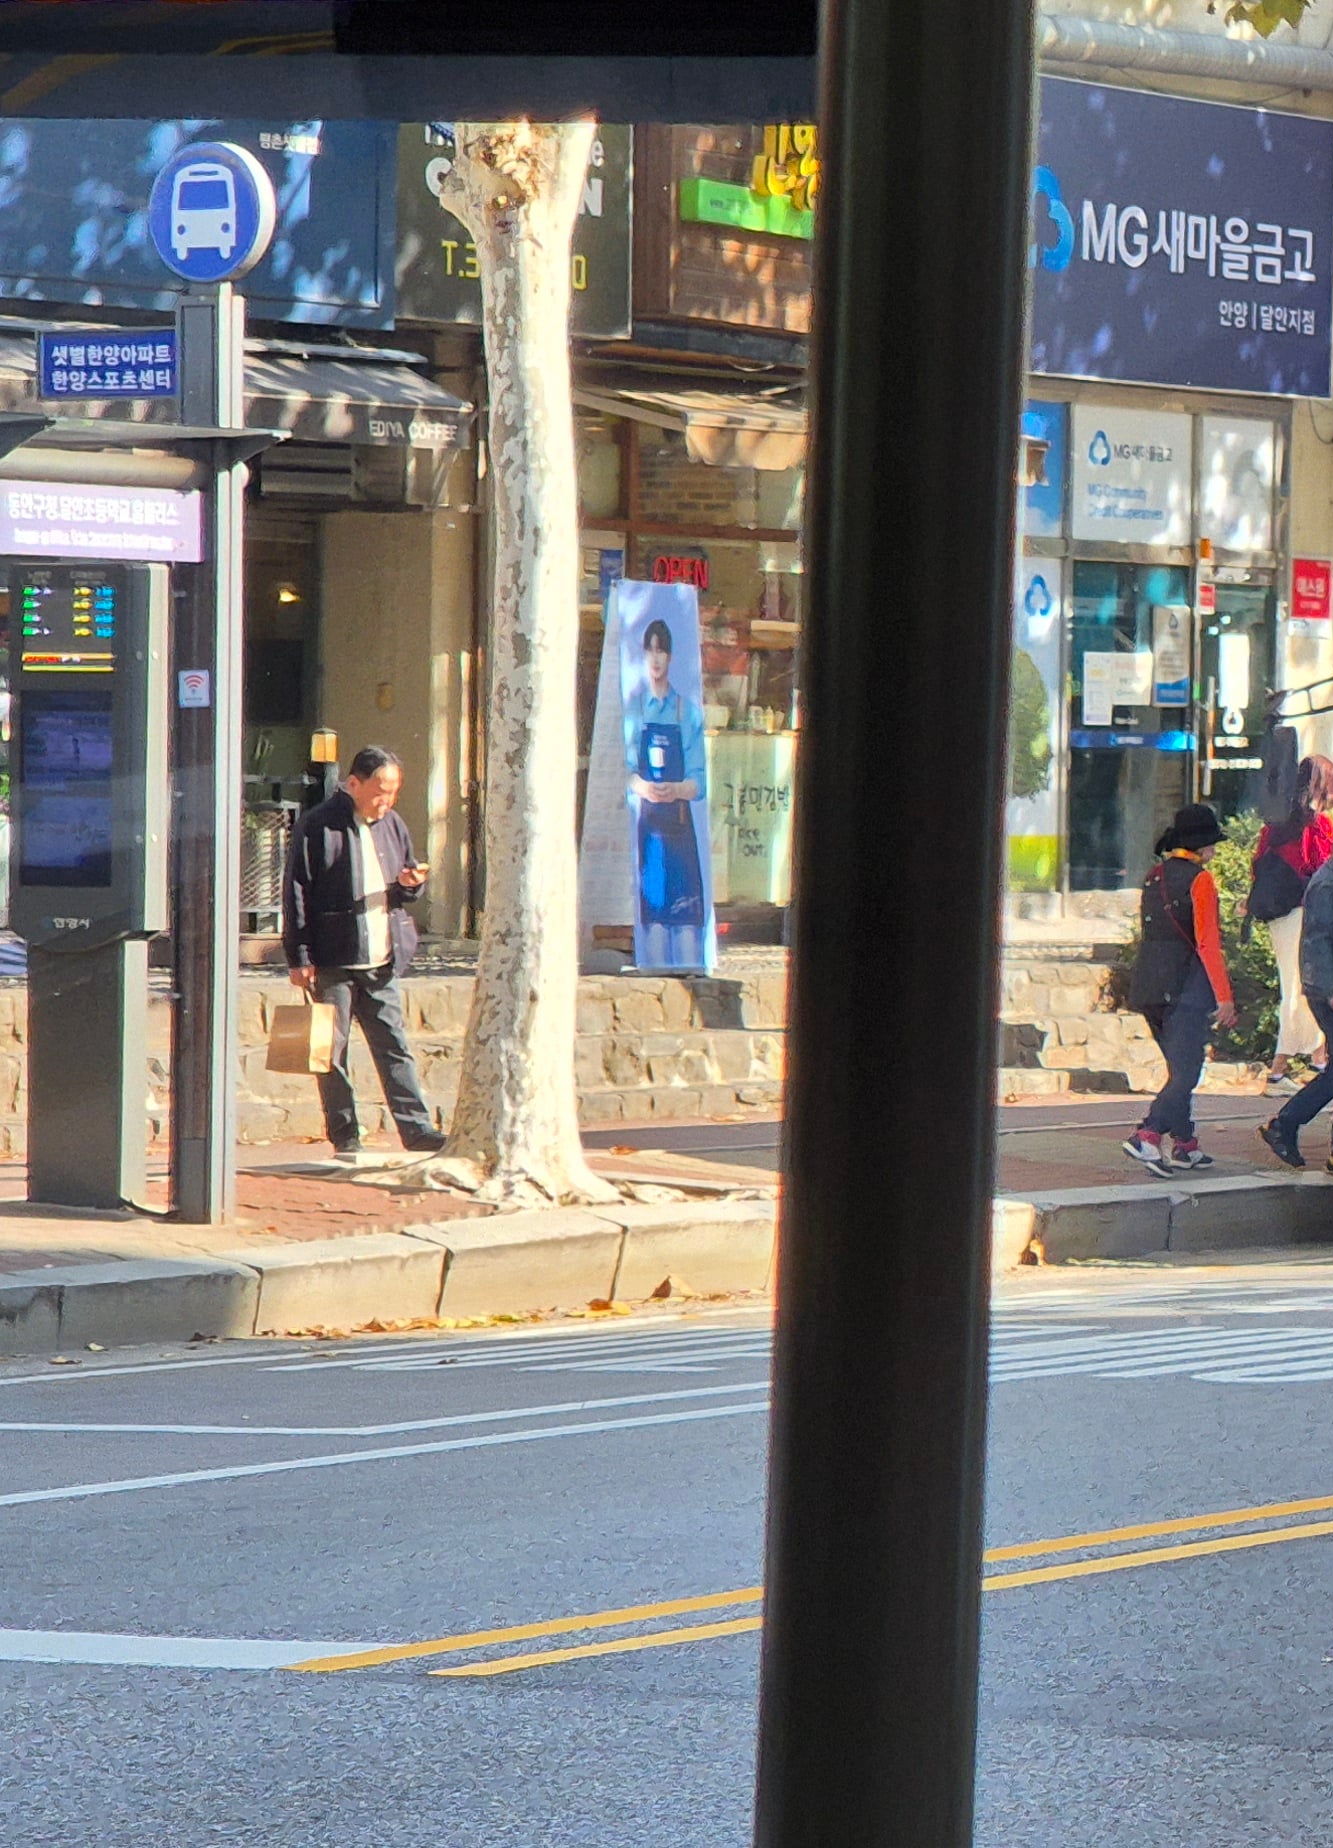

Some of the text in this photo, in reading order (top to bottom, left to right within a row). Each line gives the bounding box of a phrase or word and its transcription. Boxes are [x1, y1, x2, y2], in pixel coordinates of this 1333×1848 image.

[1219, 301, 1316, 335] 안양 달안지점
[52, 344, 171, 366] 샛별한양아파트
[51, 369, 171, 392] 한양스포츠센터
[369, 420, 458, 440] EDIYA COFFEE
[652, 556, 709, 590] OPEN
